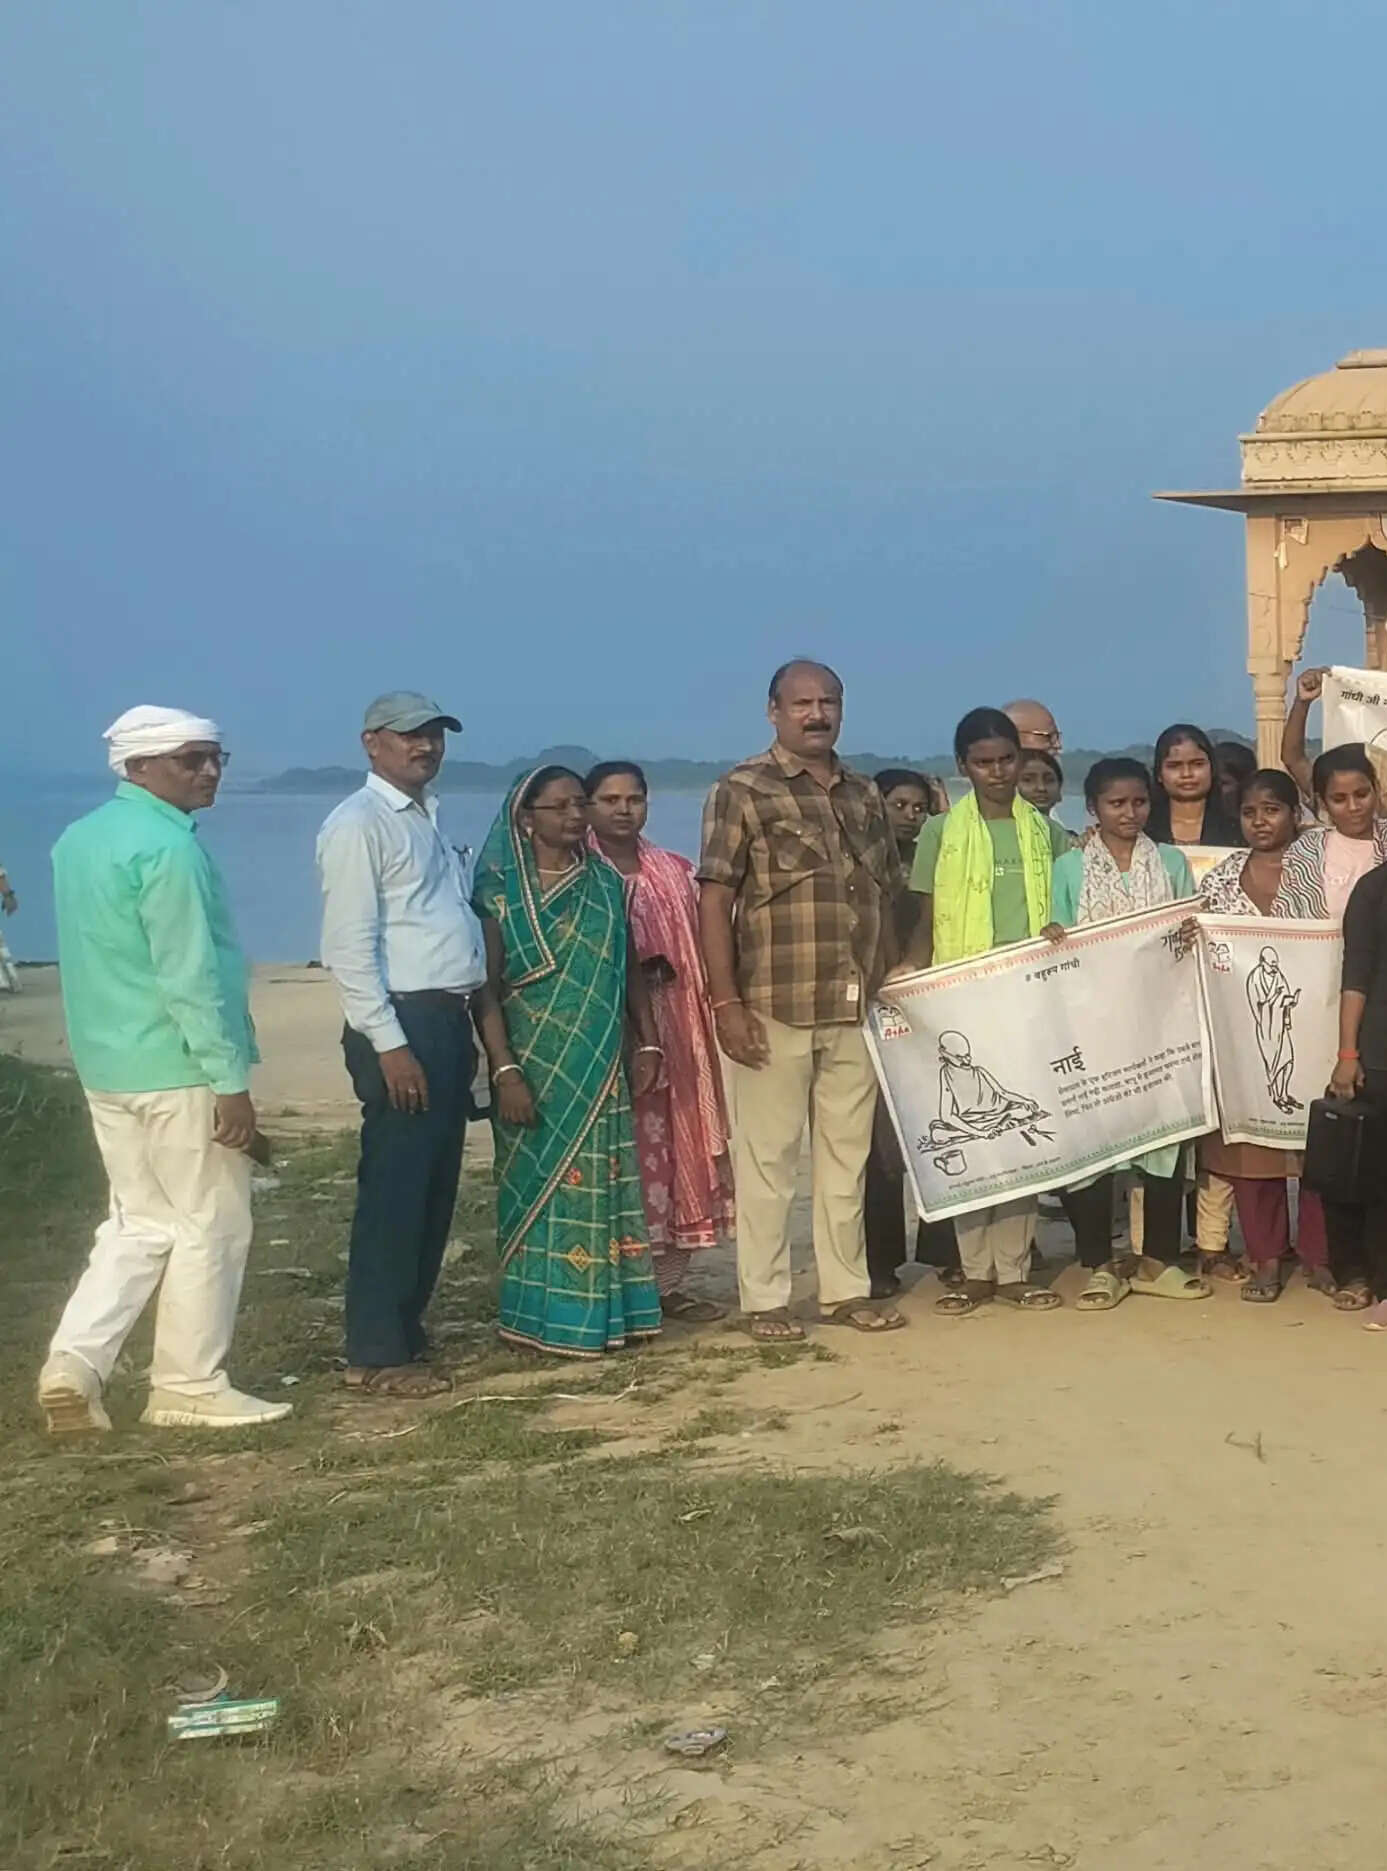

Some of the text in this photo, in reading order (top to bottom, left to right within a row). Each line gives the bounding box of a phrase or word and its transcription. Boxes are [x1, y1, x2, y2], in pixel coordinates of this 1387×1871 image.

[1341, 689, 1363, 704] गांधी
[1060, 957, 1080, 972] गांधी
[885, 1026, 909, 1039] Asha
[1050, 1046, 1086, 1075] नाई
